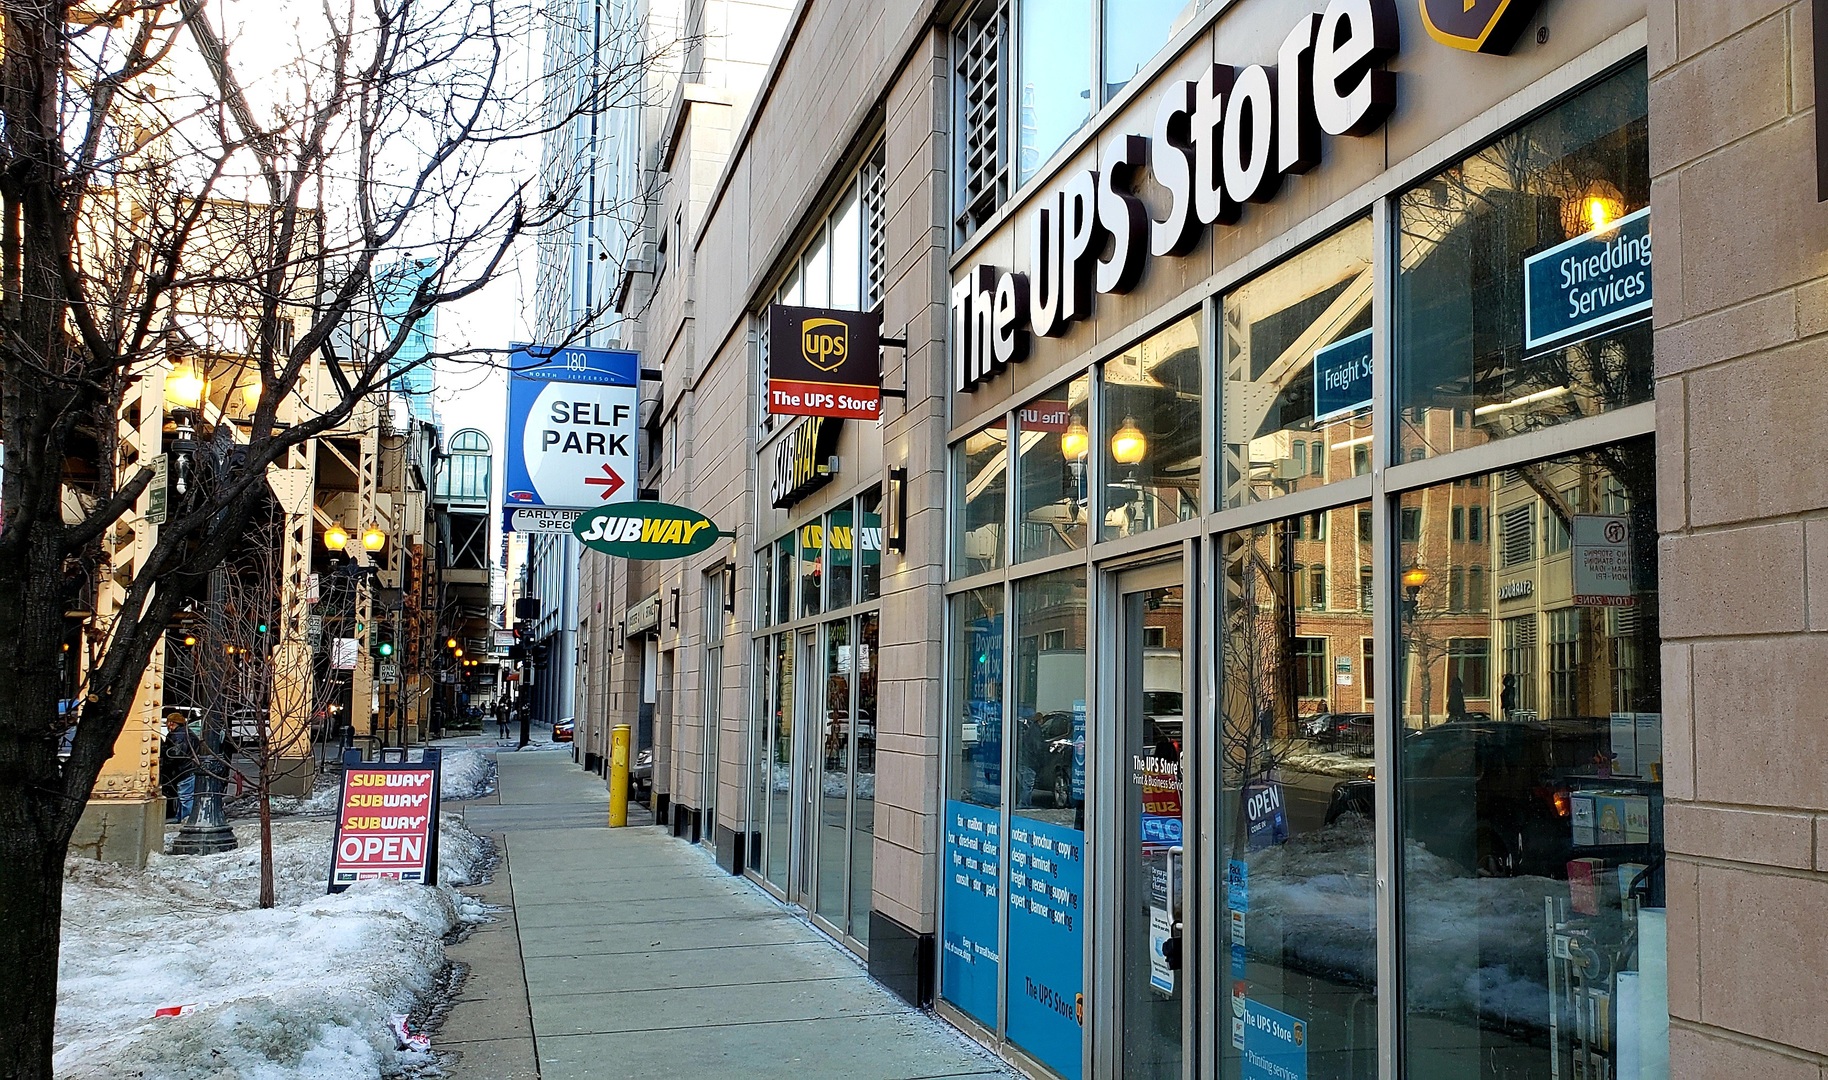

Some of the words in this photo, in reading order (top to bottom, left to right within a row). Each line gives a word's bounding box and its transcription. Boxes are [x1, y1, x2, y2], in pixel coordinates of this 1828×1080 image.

[952, 264, 1020, 393] The
[1030, 133, 1138, 338] UPS
[1151, 0, 1385, 257] Store
[1560, 235, 1652, 289] Shredding
[1569, 271, 1645, 318] Services
[565, 352, 586, 371] 180
[806, 334, 845, 362] ups
[568, 374, 615, 382] JEFFERSON
[1325, 361, 1360, 390] Freight
[551, 400, 630, 427] SELF
[773, 391, 800, 406] The
[804, 393, 834, 408] UPS
[838, 395, 877, 411] Store
[542, 429, 629, 457] PARK
[771, 416, 825, 504] SUBWAY
[518, 509, 558, 519] EARLY
[562, 511, 582, 520] BIR
[539, 520, 574, 529] SPEC
[581, 516, 710, 544] SUBWAY
[1133, 755, 1145, 771] The
[1146, 756, 1159, 773] UPS
[1160, 758, 1178, 775] Store
[350, 773, 430, 788] SUBWAY
[1132, 773, 1144, 785] Print
[1144, 774, 1148, 785] &
[1148, 775, 1168, 789] Business
[346, 793, 428, 808] SUBWAY
[1248, 784, 1280, 821] OPEN
[344, 815, 426, 831] SUBWAY
[340, 837, 422, 862] OPEN
[1025, 975, 1037, 1000] The
[1039, 983, 1053, 1008] UPS
[1054, 992, 1073, 1020] Store
[1243, 1009, 1256, 1026] The
[1256, 1014, 1271, 1034] UPS
[1272, 1020, 1292, 1042] Store
[1248, 1049, 1273, 1076] Printing
